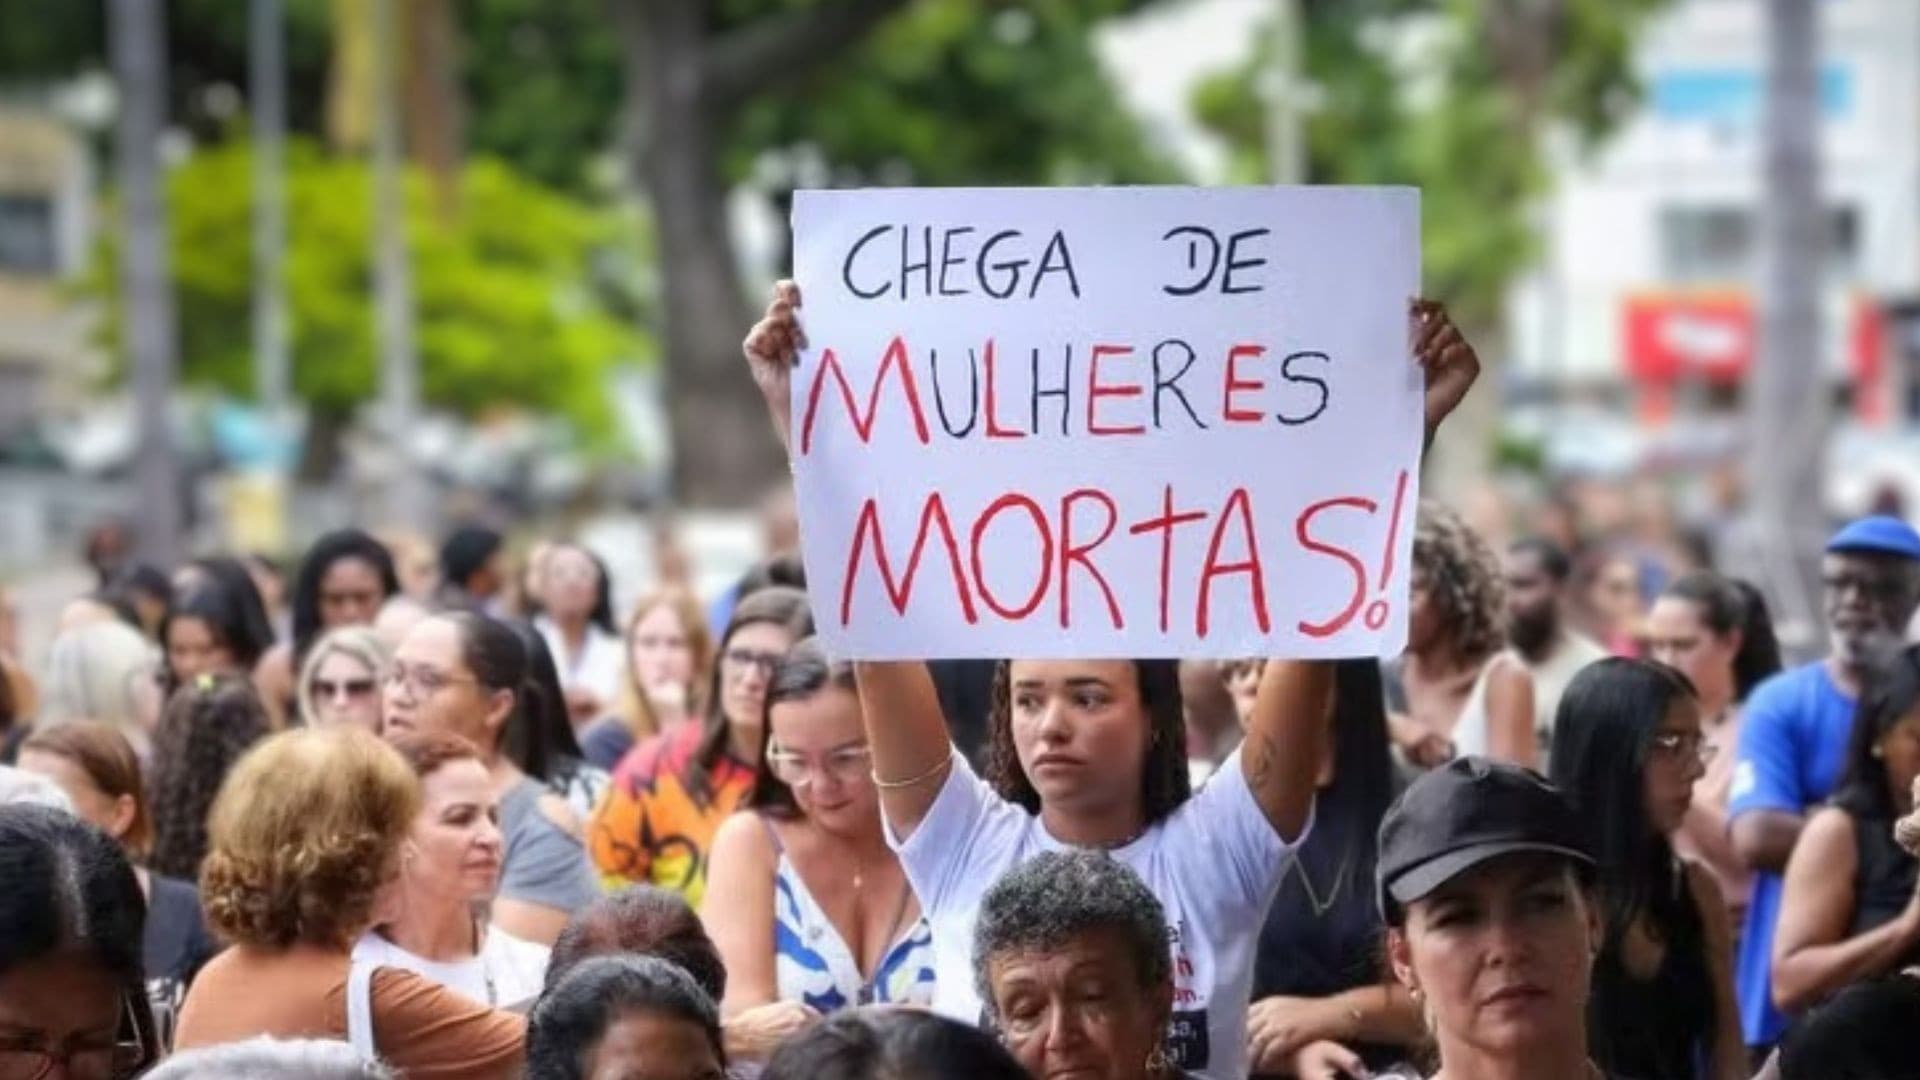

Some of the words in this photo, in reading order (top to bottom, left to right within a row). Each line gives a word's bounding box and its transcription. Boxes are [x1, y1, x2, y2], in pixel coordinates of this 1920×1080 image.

[843, 225, 1080, 300] CHEGA
[1162, 226, 1270, 297] DE
[801, 335, 1331, 455] MULHERES
[840, 469, 1408, 639] MORTAS!
